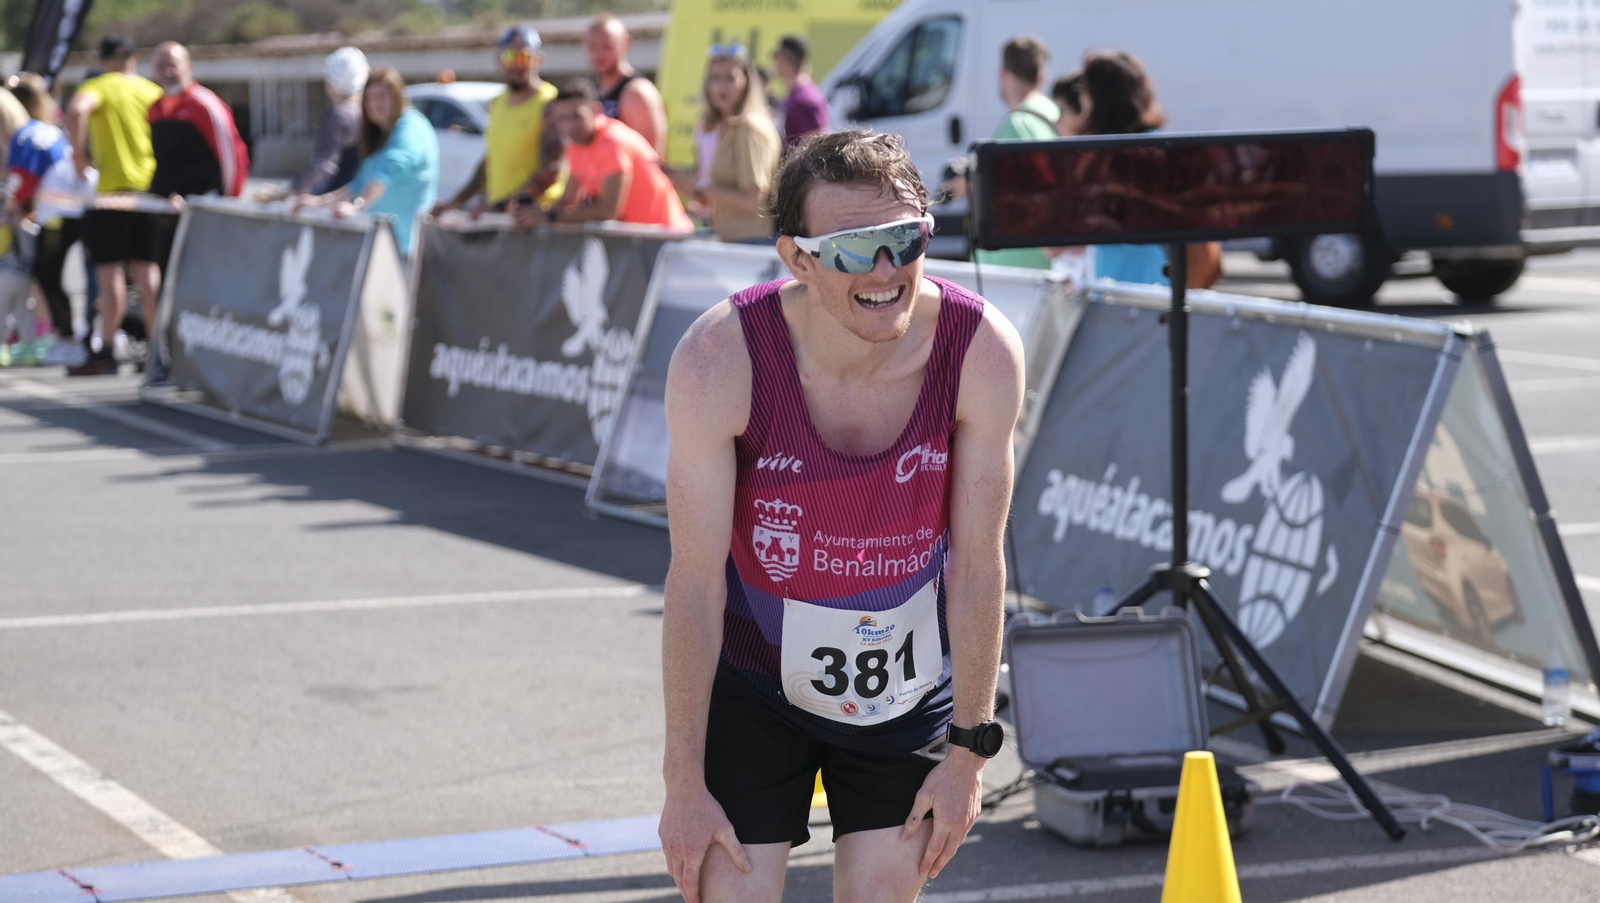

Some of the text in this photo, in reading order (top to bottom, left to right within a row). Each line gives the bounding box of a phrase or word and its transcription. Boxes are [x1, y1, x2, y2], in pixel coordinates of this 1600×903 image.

[430, 335, 591, 404] aquéatacamos
[813, 525, 933, 549] Ayuntamiento de
[855, 624, 895, 635] 10km20
[810, 629, 916, 699] 381
